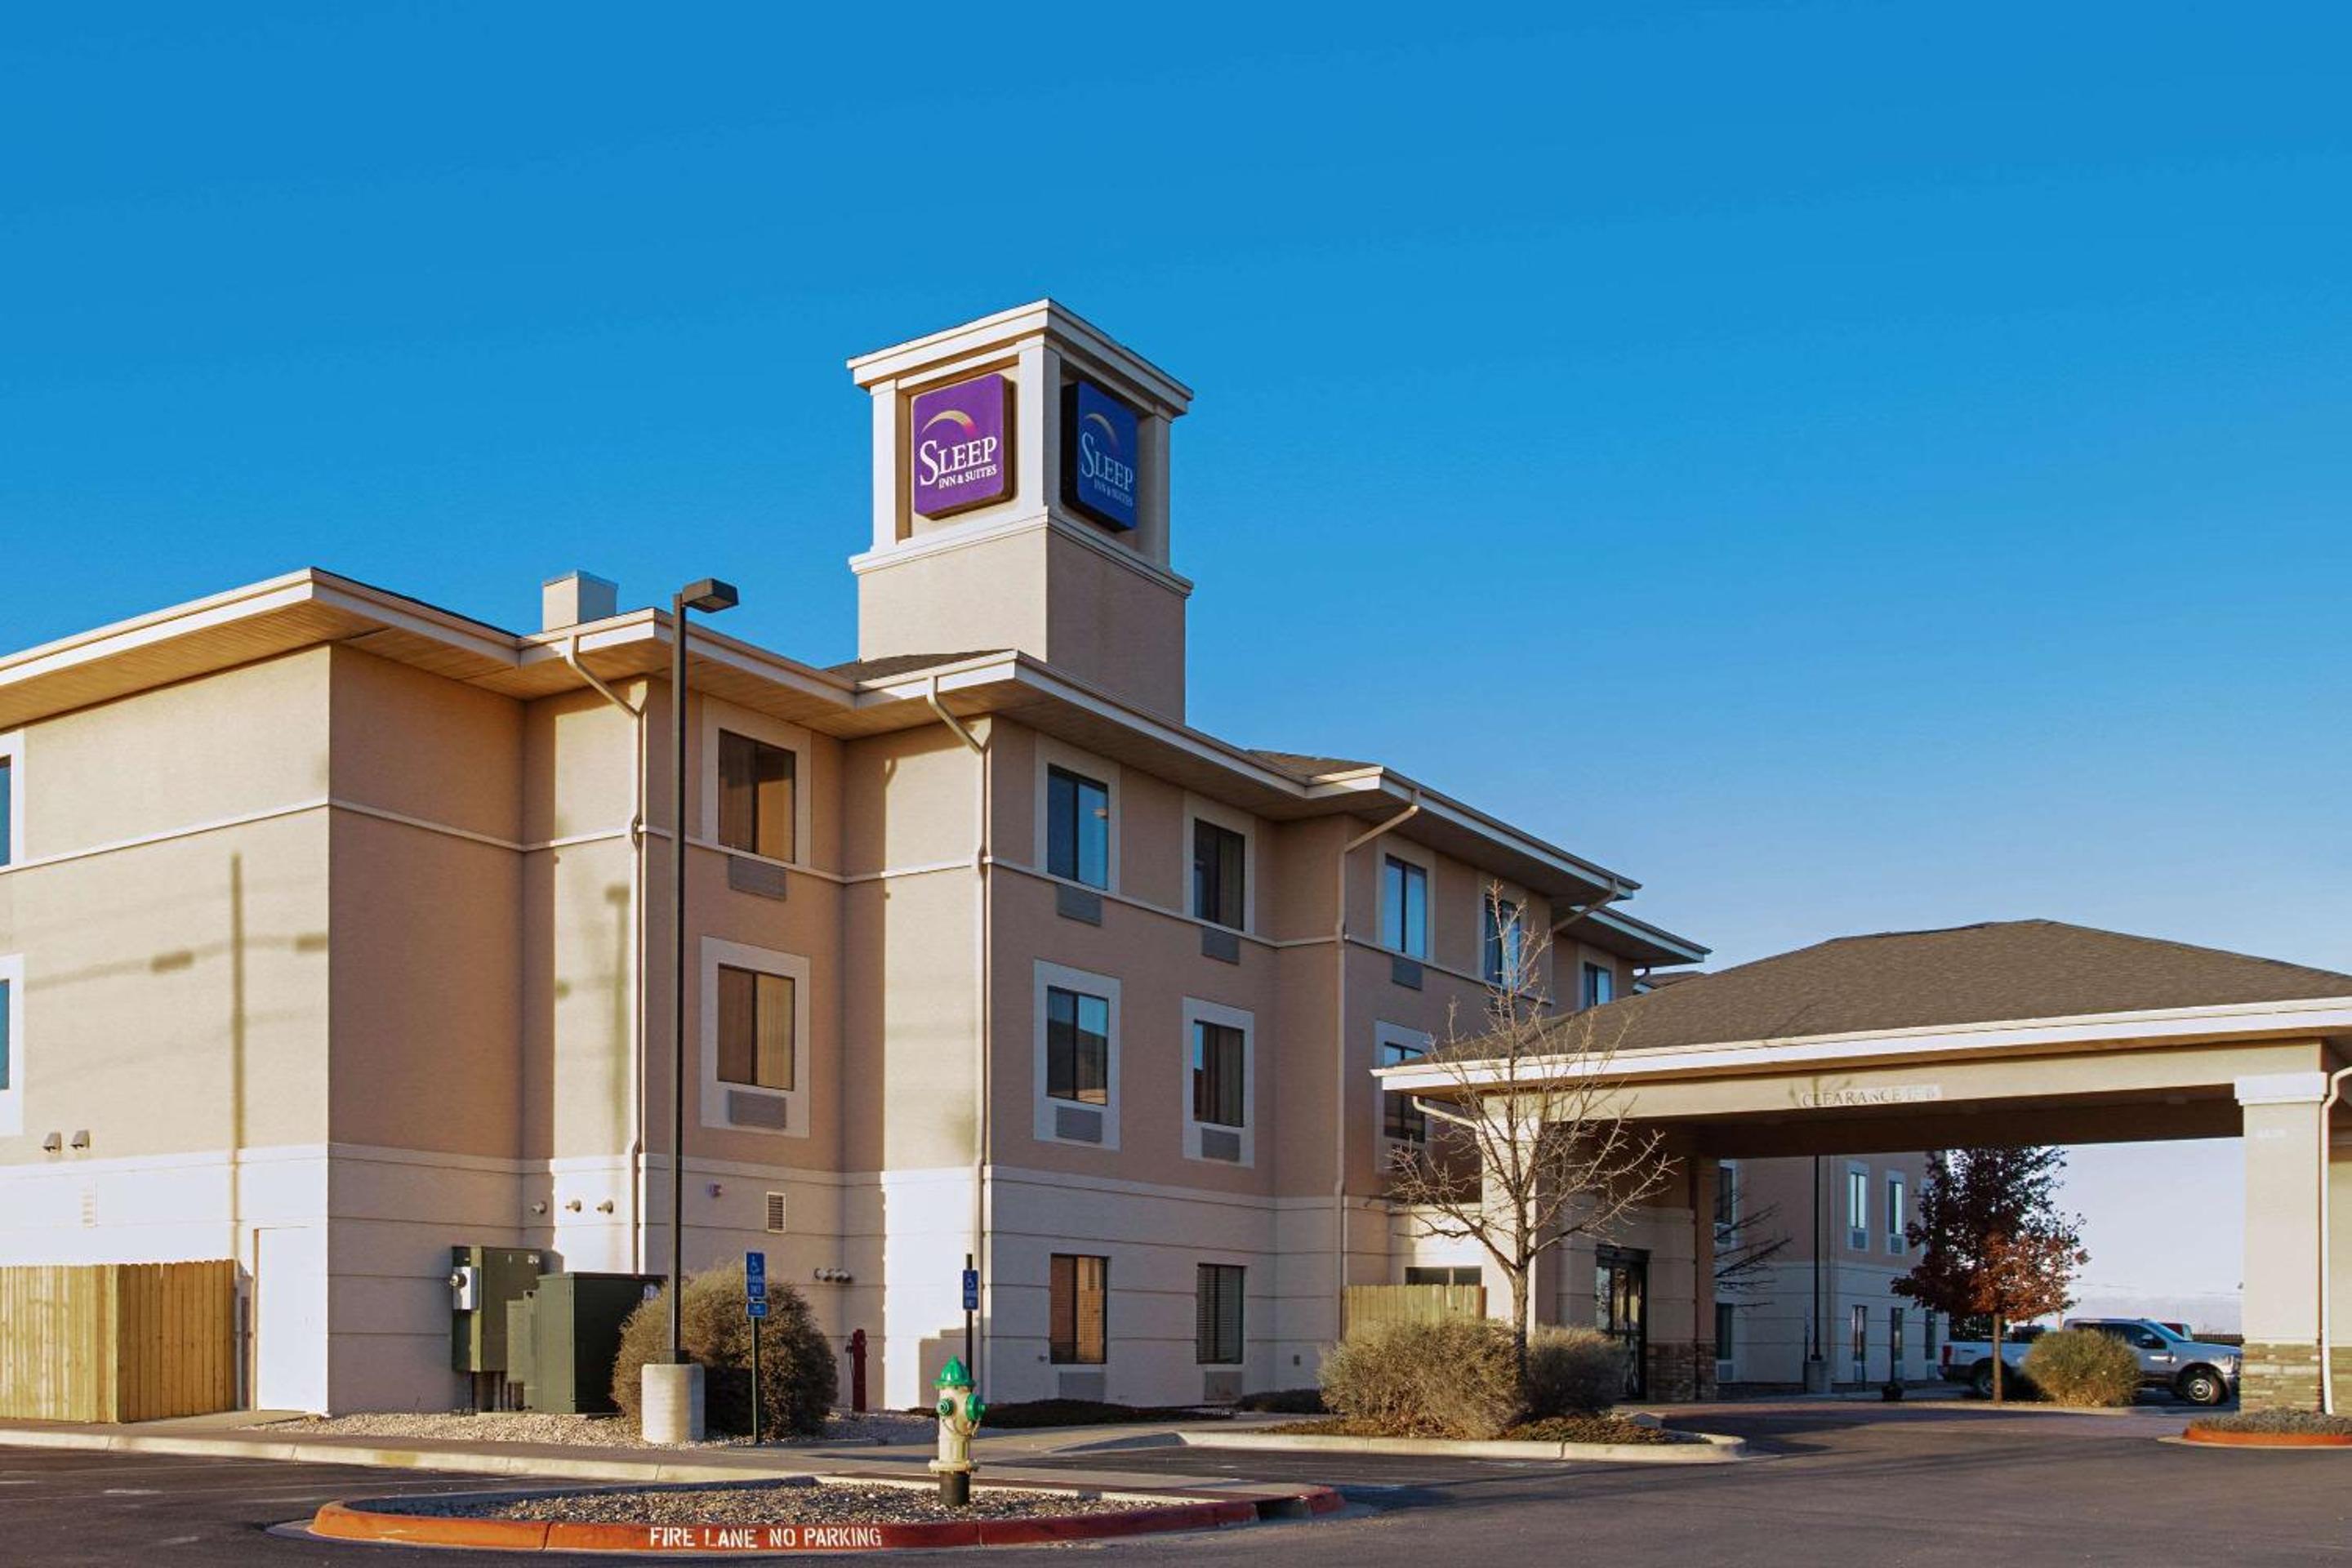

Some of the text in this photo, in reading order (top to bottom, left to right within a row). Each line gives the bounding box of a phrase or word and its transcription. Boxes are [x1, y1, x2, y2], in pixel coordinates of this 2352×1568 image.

[920, 437, 997, 486] SLEEP
[938, 474, 956, 489] INN
[965, 465, 997, 482] SUITES
[1081, 432, 1133, 491] SLEEP
[649, 1526, 882, 1548] FIRE LANE NO PARKING
